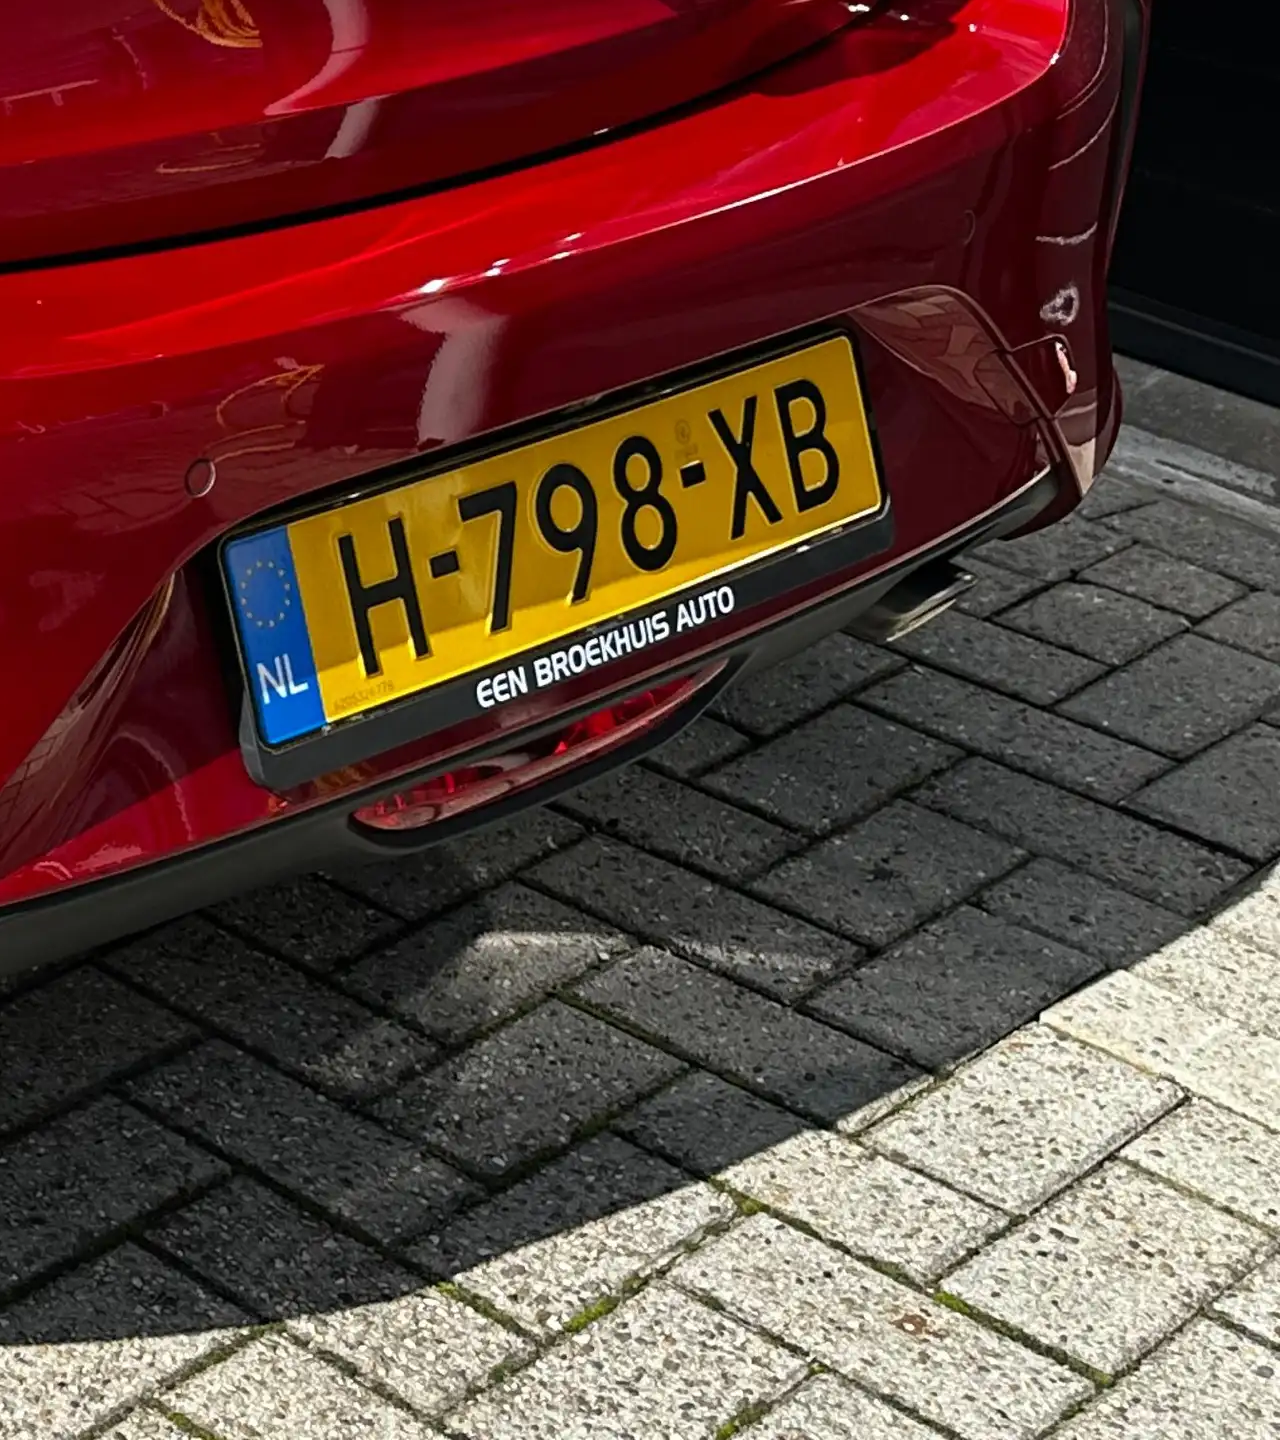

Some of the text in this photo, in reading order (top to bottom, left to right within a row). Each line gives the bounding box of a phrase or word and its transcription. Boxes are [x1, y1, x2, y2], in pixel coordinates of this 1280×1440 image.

[337, 377, 841, 679] H-798-XB
[257, 653, 309, 705] NL
[476, 585, 735, 709] EEN BROEKHUIS AUTO
